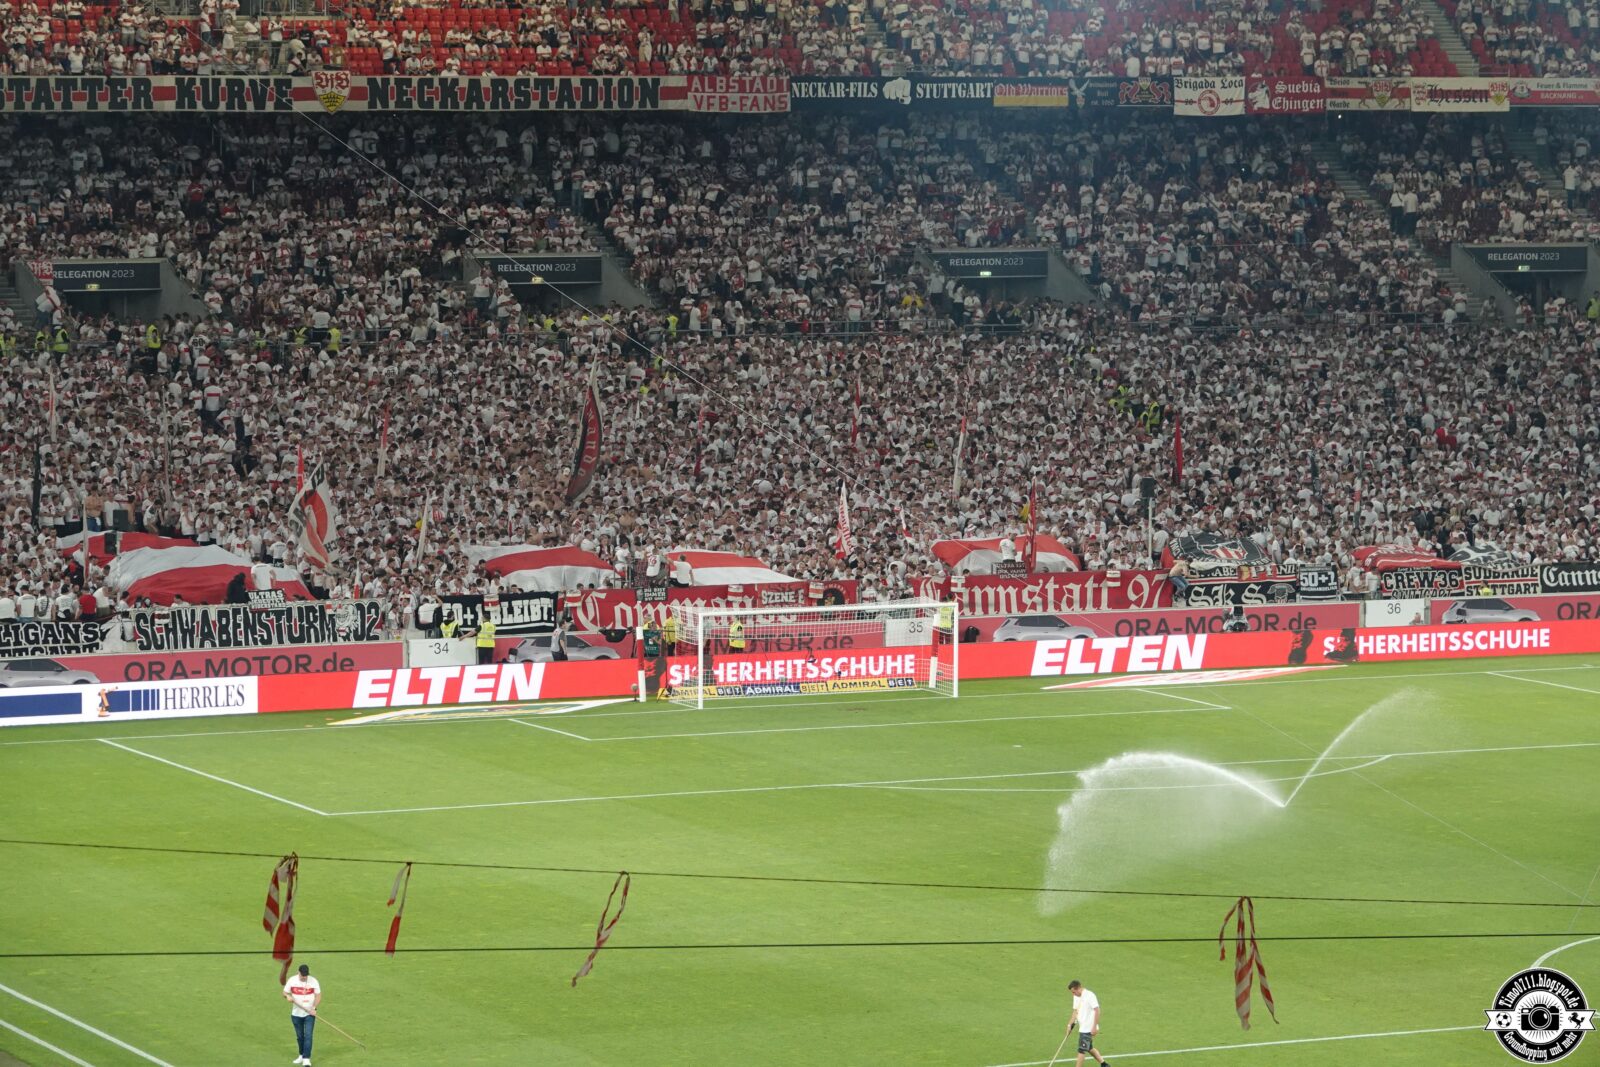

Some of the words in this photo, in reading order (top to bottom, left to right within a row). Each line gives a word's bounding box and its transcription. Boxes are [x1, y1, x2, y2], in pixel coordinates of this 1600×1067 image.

[691, 76, 788, 93] ALBSTADT
[792, 82, 878, 99] NECKAR-FILS
[916, 82, 993, 99] STUTTGART
[1017, 83, 1068, 97] Warriors
[1174, 79, 1216, 91] Brigada
[1220, 79, 1244, 90] Loca
[1275, 81, 1321, 94] Suebia
[0, 78, 153, 110] TATTER
[175, 78, 292, 110] KURVE
[367, 77, 660, 110] NECKARSTADION
[1428, 83, 1489, 107] Hessen
[692, 94, 788, 111] VFB-FANS
[1271, 95, 1325, 112] Ehingen
[950, 258, 1002, 266] RELEGATION
[1004, 257, 1024, 266] 2023
[1488, 252, 1538, 261] RELEGATION
[1540, 252, 1560, 261] 2023
[53, 270, 109, 279] RELEGATION
[111, 269, 135, 278] 2023
[498, 263, 553, 273] RELEGATION
[555, 263, 576, 272] 2023
[1300, 572, 1337, 587] 50+1
[248, 590, 283, 599] ULTRAS
[1127, 573, 1168, 609] 97
[1465, 583, 1539, 597] STTTGART
[1387, 603, 1401, 614] 36
[908, 621, 924, 634] 35
[1115, 612, 1317, 637] ORA-MOOR.de
[1323, 628, 1551, 656] SHERHEITSSCHUHE
[1031, 633, 1208, 677] ELTEN
[124, 652, 355, 684] ORA-MOTOR.de
[669, 654, 916, 687] SIHERHEITSSCHUHE
[352, 663, 547, 709] ELTEN
[746, 684, 800, 696] ADMIRAL
[832, 680, 887, 690] ADMIRAL
[887, 678, 914, 687] BET
[163, 683, 245, 710] HERRLES
